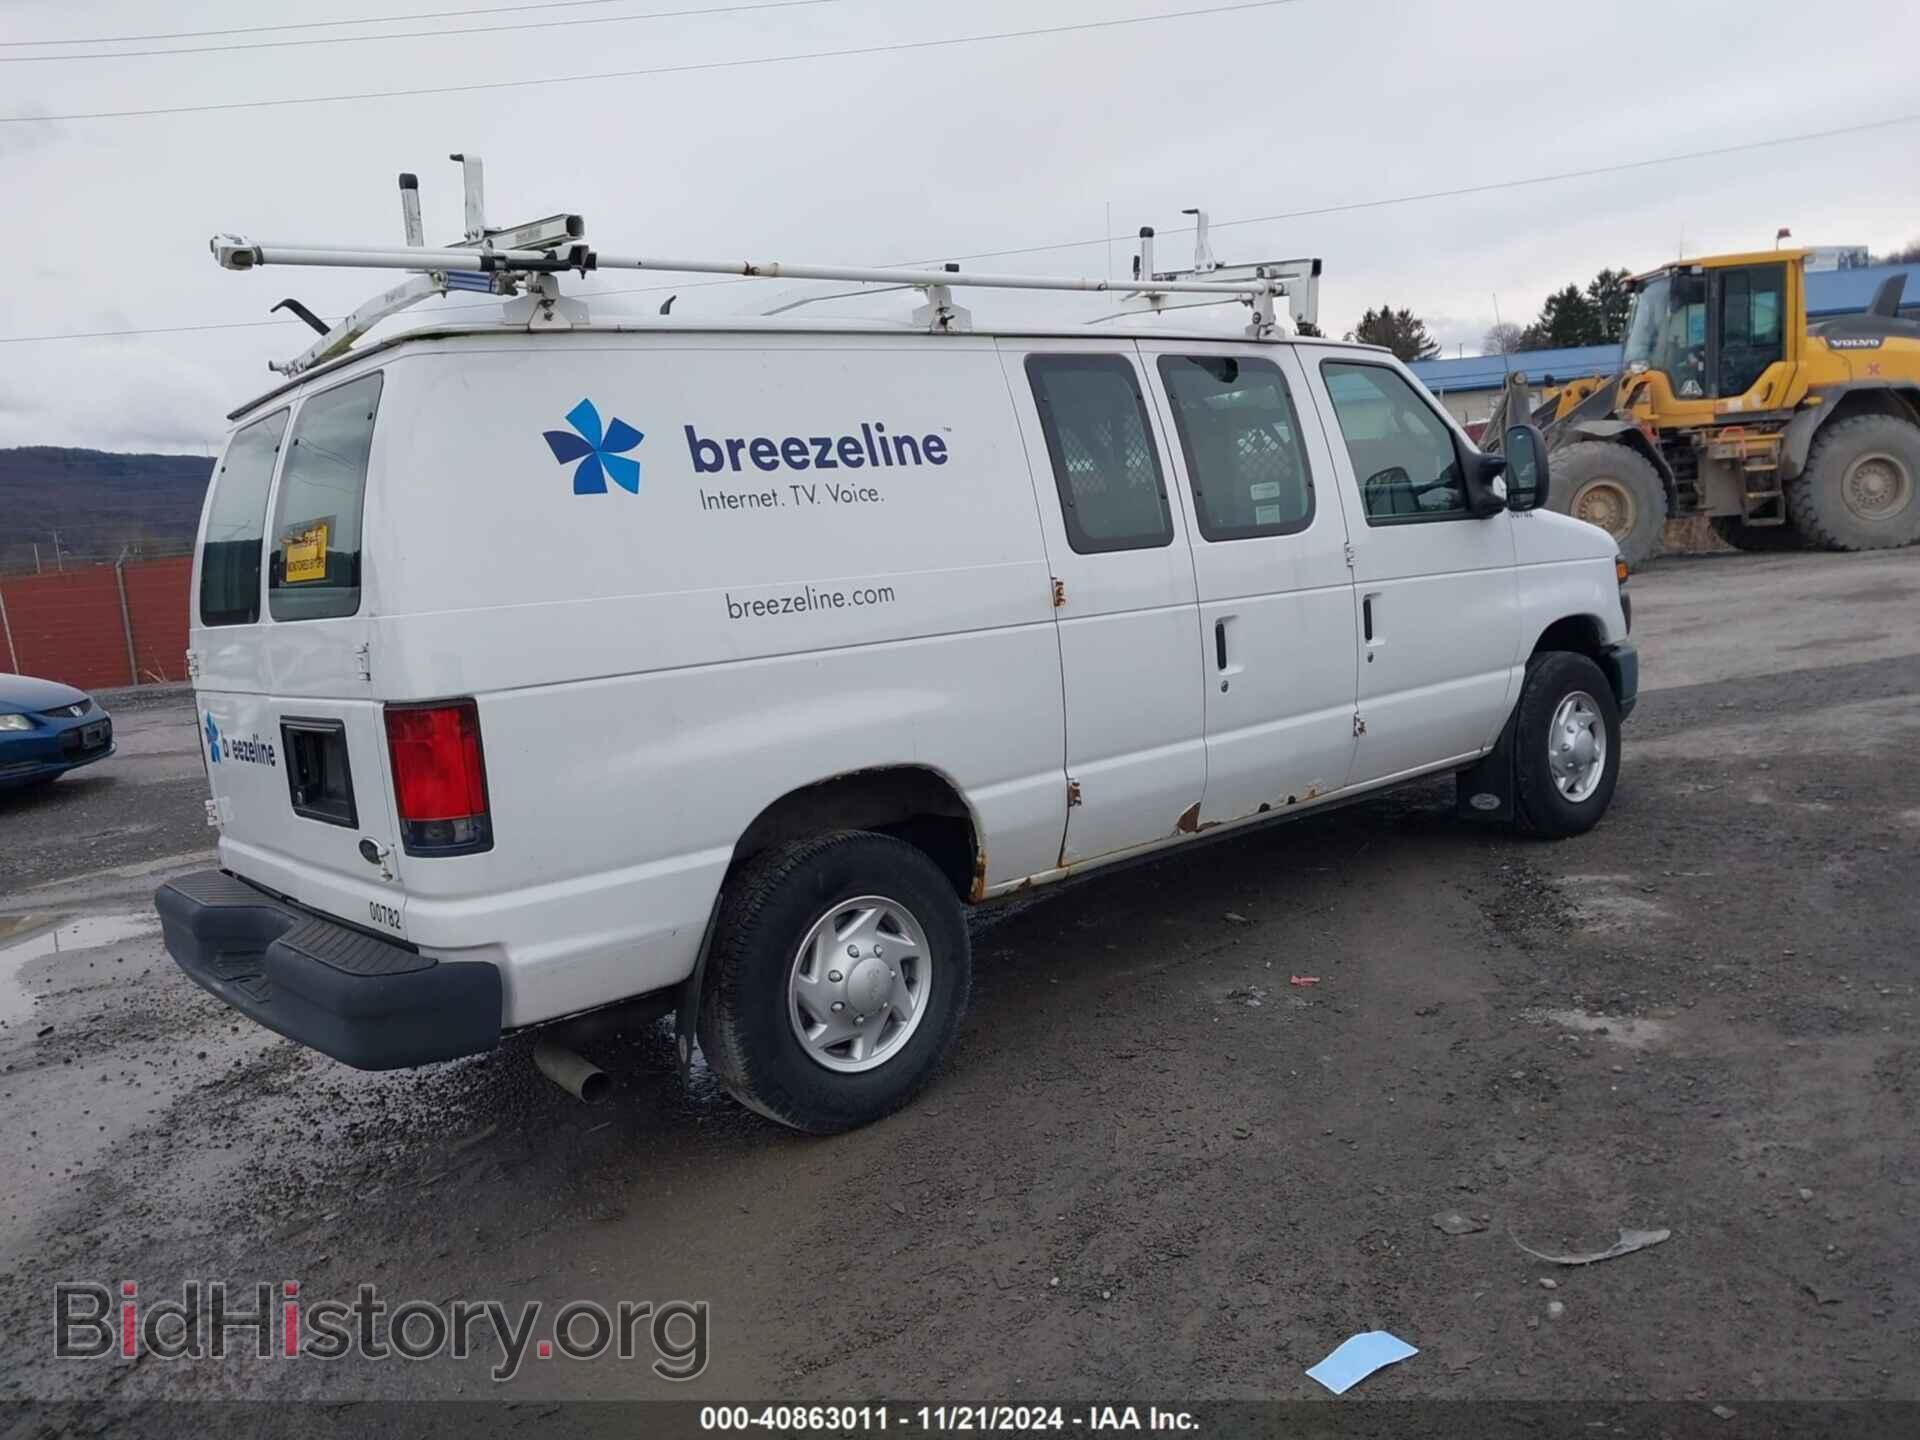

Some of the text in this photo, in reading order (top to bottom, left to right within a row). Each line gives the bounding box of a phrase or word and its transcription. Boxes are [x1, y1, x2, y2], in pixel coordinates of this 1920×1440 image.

[1830, 338, 1880, 347] VOLVO
[684, 422, 948, 473] breezeline
[699, 482, 885, 511] Internet. TV. Voice.
[725, 584, 895, 619] breezeline.com
[369, 901, 402, 929] 00782
